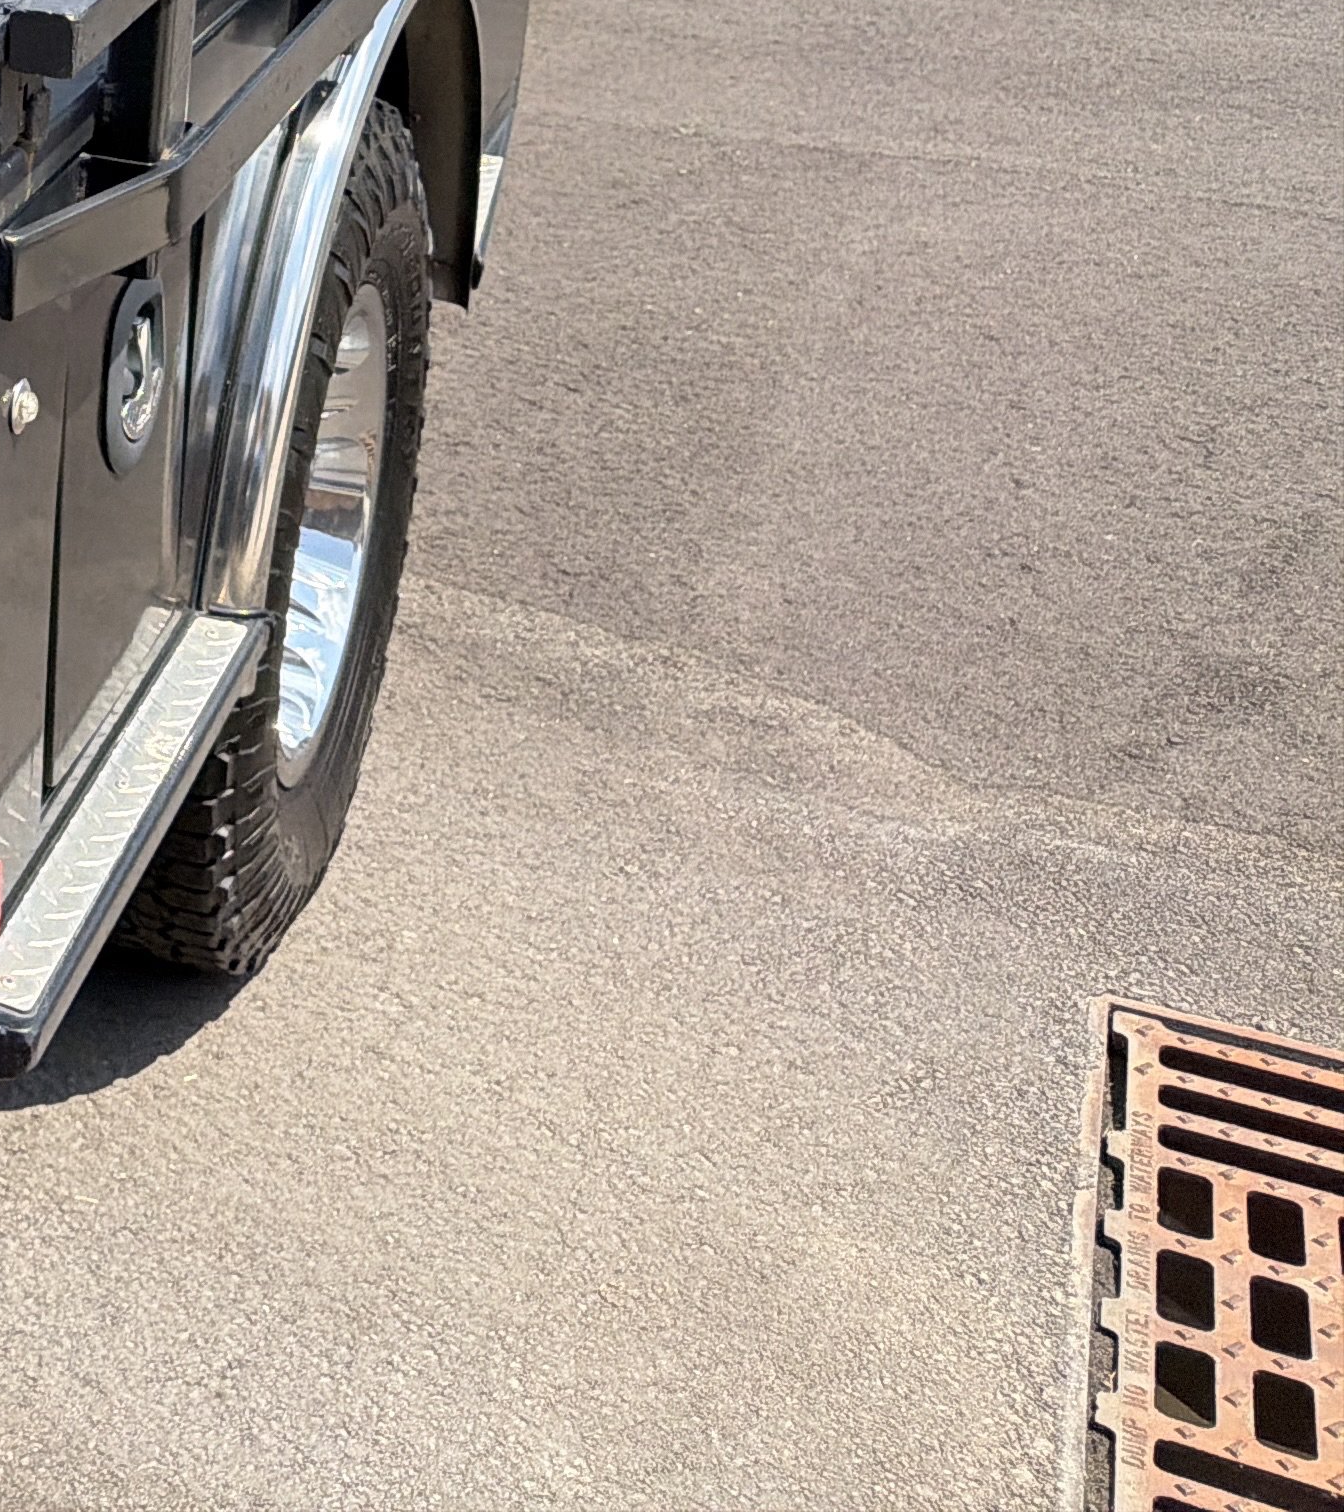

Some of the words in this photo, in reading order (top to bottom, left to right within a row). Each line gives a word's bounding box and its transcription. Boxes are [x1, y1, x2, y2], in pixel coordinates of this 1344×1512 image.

[1128, 1110, 1154, 1195] WATERWAYS
[1127, 1202, 1154, 1223] TO
[1125, 1230, 1152, 1296] DRAINS
[1122, 1383, 1149, 1412] NO
[1120, 1416, 1149, 1471] DUMP
